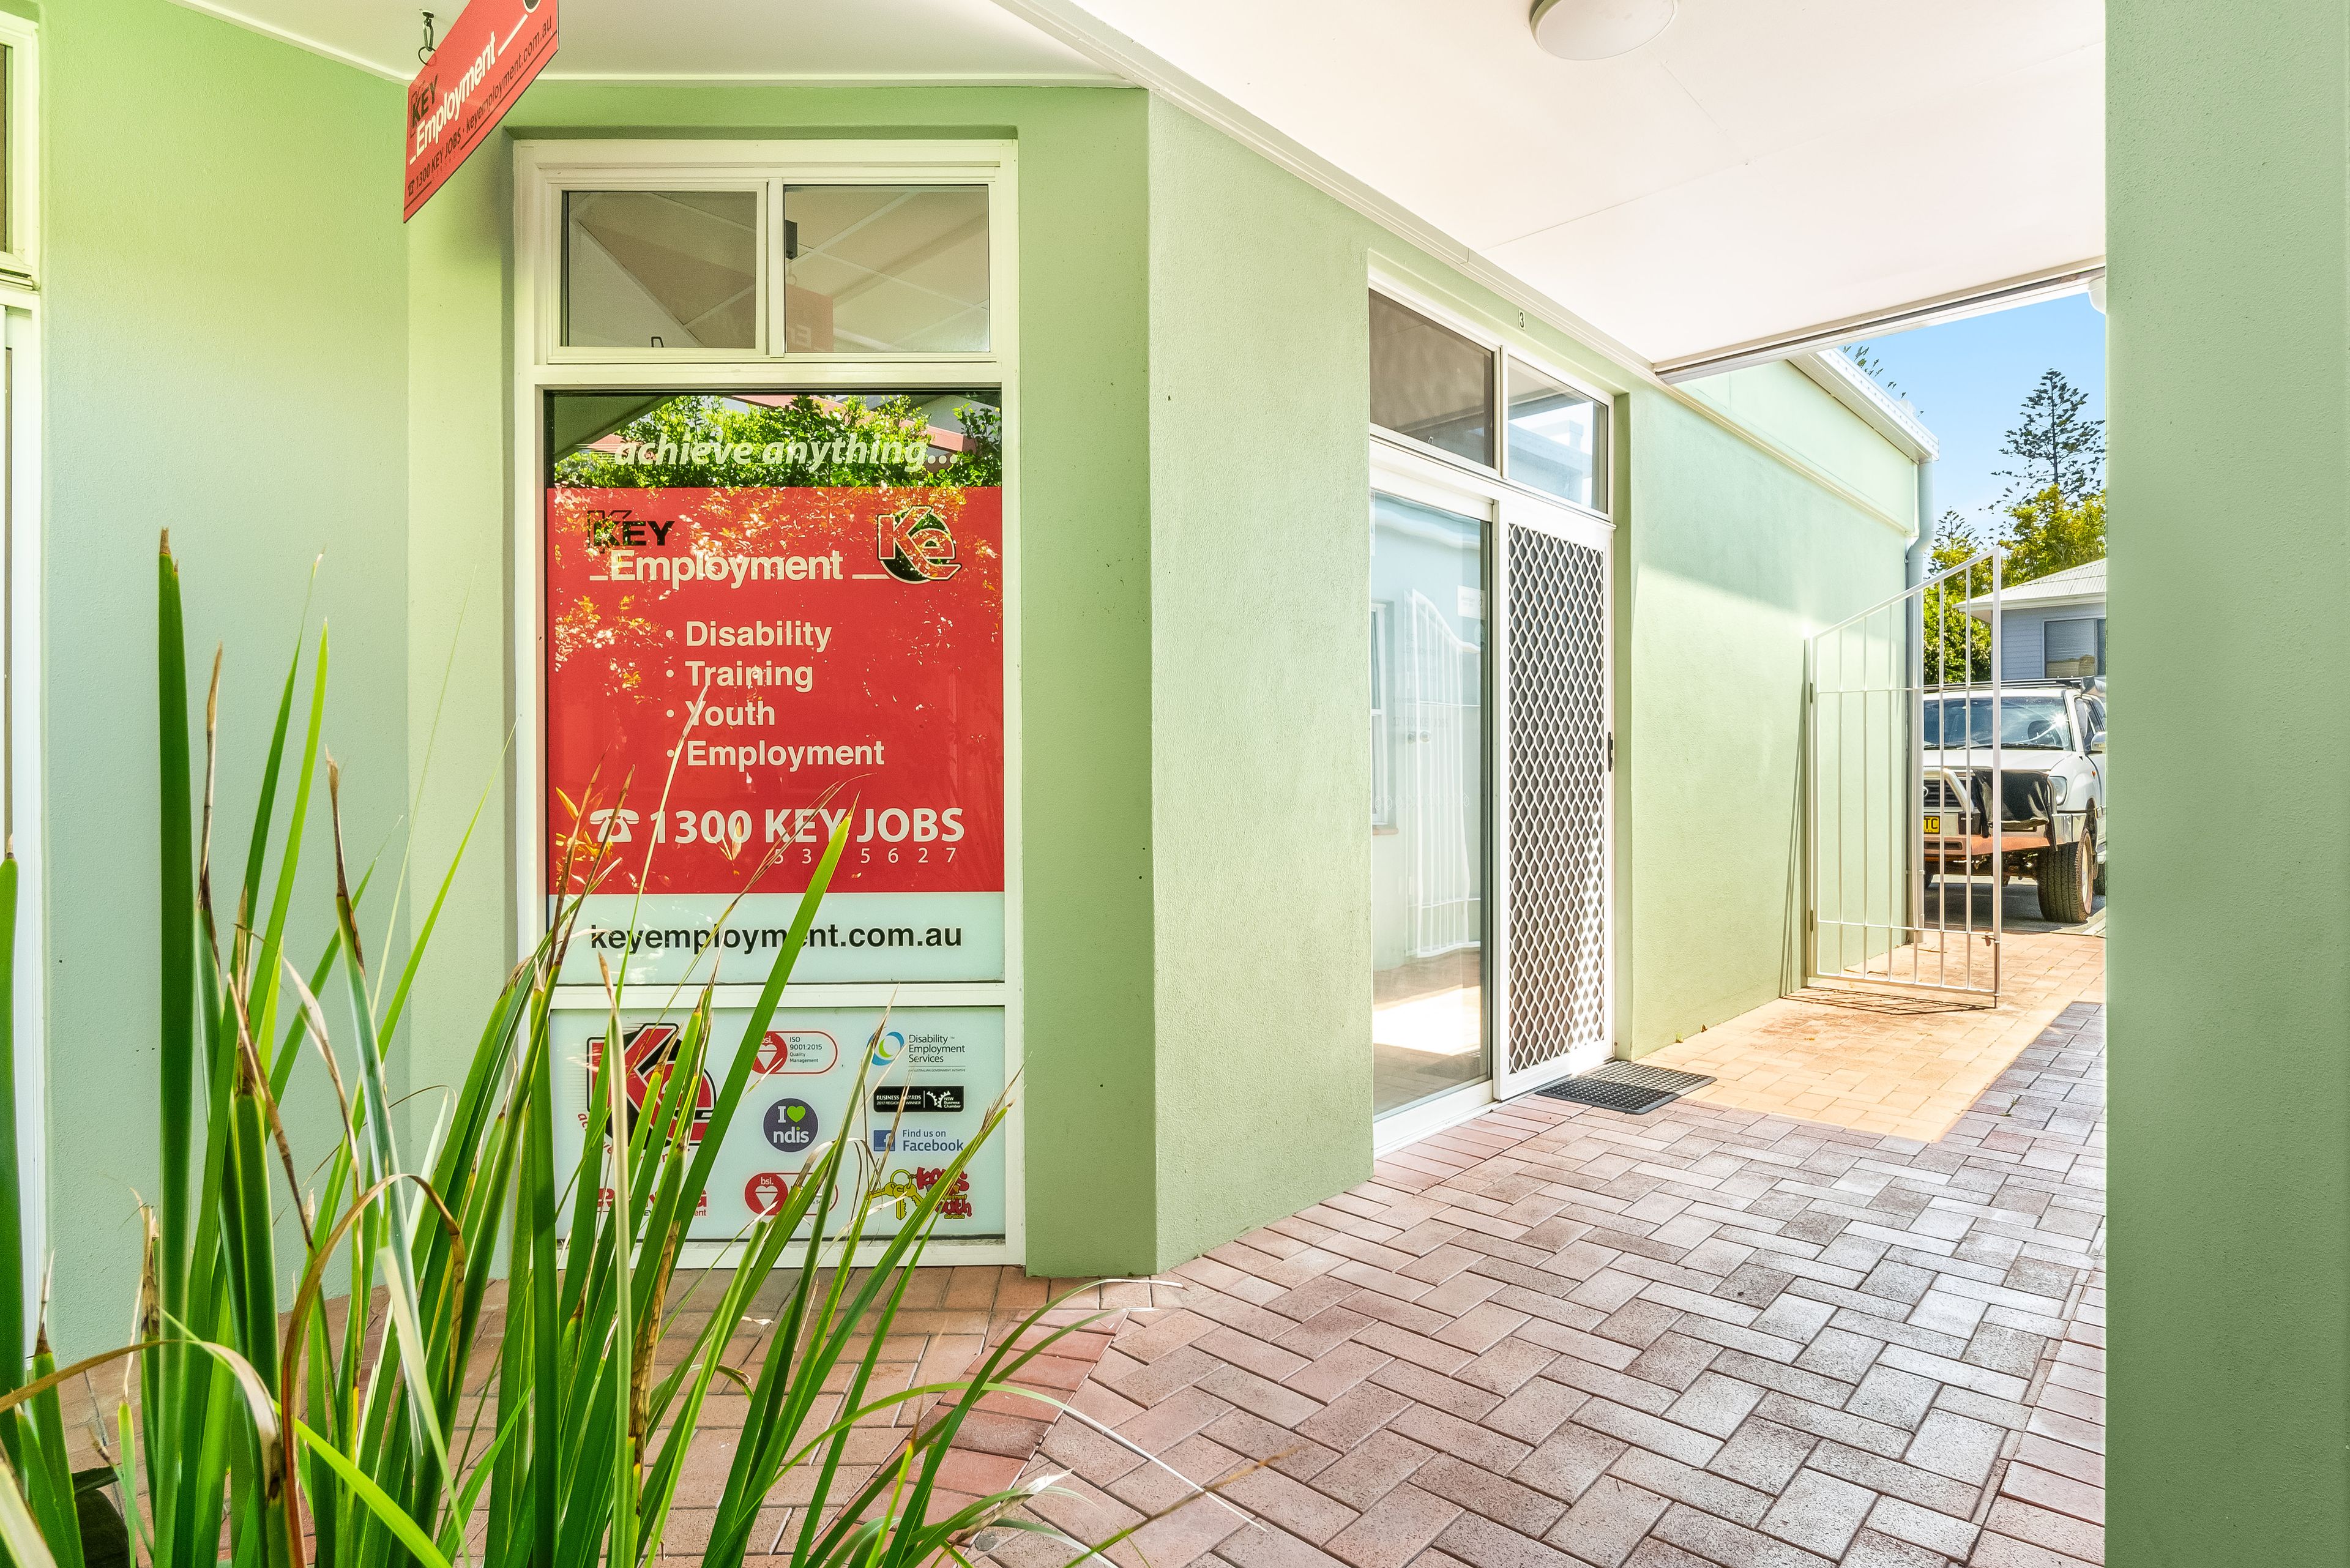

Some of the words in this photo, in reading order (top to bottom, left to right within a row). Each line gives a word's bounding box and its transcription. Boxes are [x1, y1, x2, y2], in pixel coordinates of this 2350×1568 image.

[411, 74, 438, 138] KEY
[416, 162, 430, 190] 1300
[431, 146, 444, 173] KEY
[445, 127, 461, 160] JOBS
[466, 15, 552, 133] keyemployment.com.au
[417, 31, 496, 159] Employment
[1520, 312, 1524, 328] 3
[614, 432, 752, 465] achieve
[763, 432, 958, 472] anything...
[588, 510, 676, 554] KEY
[611, 549, 843, 591] Employment
[686, 621, 832, 653] Disability
[685, 660, 813, 693] Training
[687, 739, 886, 772] Employment
[650, 810, 753, 844] 1300
[765, 808, 847, 843] KEY
[856, 807, 965, 843] JOBS
[591, 924, 962, 955] keyemploymnt.com.au
[908, 1044, 965, 1055] Employment
[909, 1034, 949, 1044] Disability
[908, 1054, 944, 1063] Services
[778, 1106, 786, 1123] I
[773, 1126, 810, 1143] ndis
[903, 1139, 964, 1151] Facebook
[760, 1176, 774, 1185] bsi.
